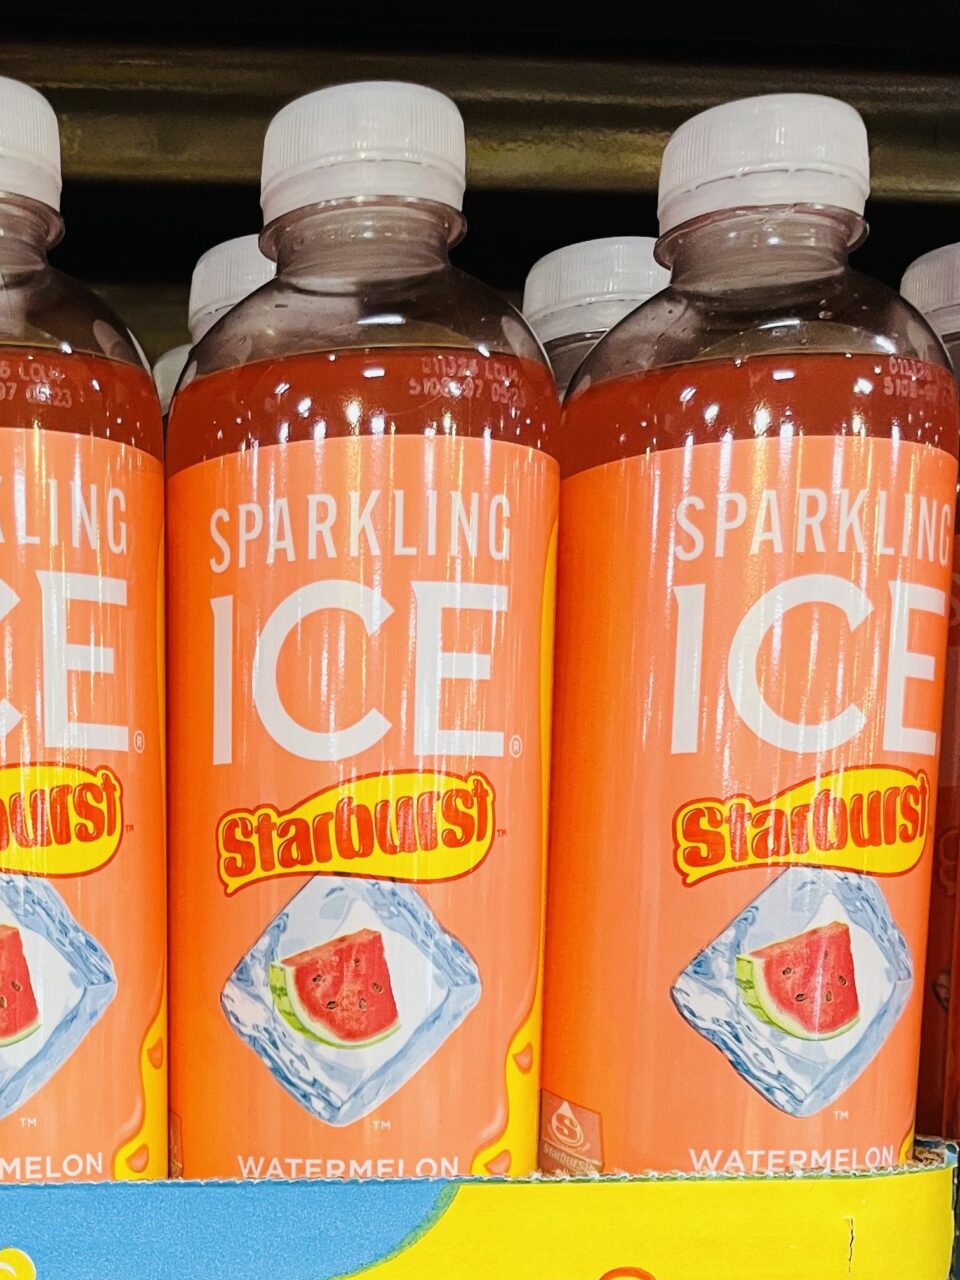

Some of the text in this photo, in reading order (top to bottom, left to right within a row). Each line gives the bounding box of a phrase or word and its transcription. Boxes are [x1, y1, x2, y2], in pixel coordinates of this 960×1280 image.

[210, 491, 511, 574] SPARKLING
[673, 488, 952, 568] SPARKLING
[210, 578, 508, 765] ICE
[670, 574, 947, 757] ICE
[223, 775, 494, 879] Starburst
[683, 773, 929, 868] Starburst
[237, 1155, 459, 1178] WATERMELON
[688, 1145, 895, 1173] WATERMELON
